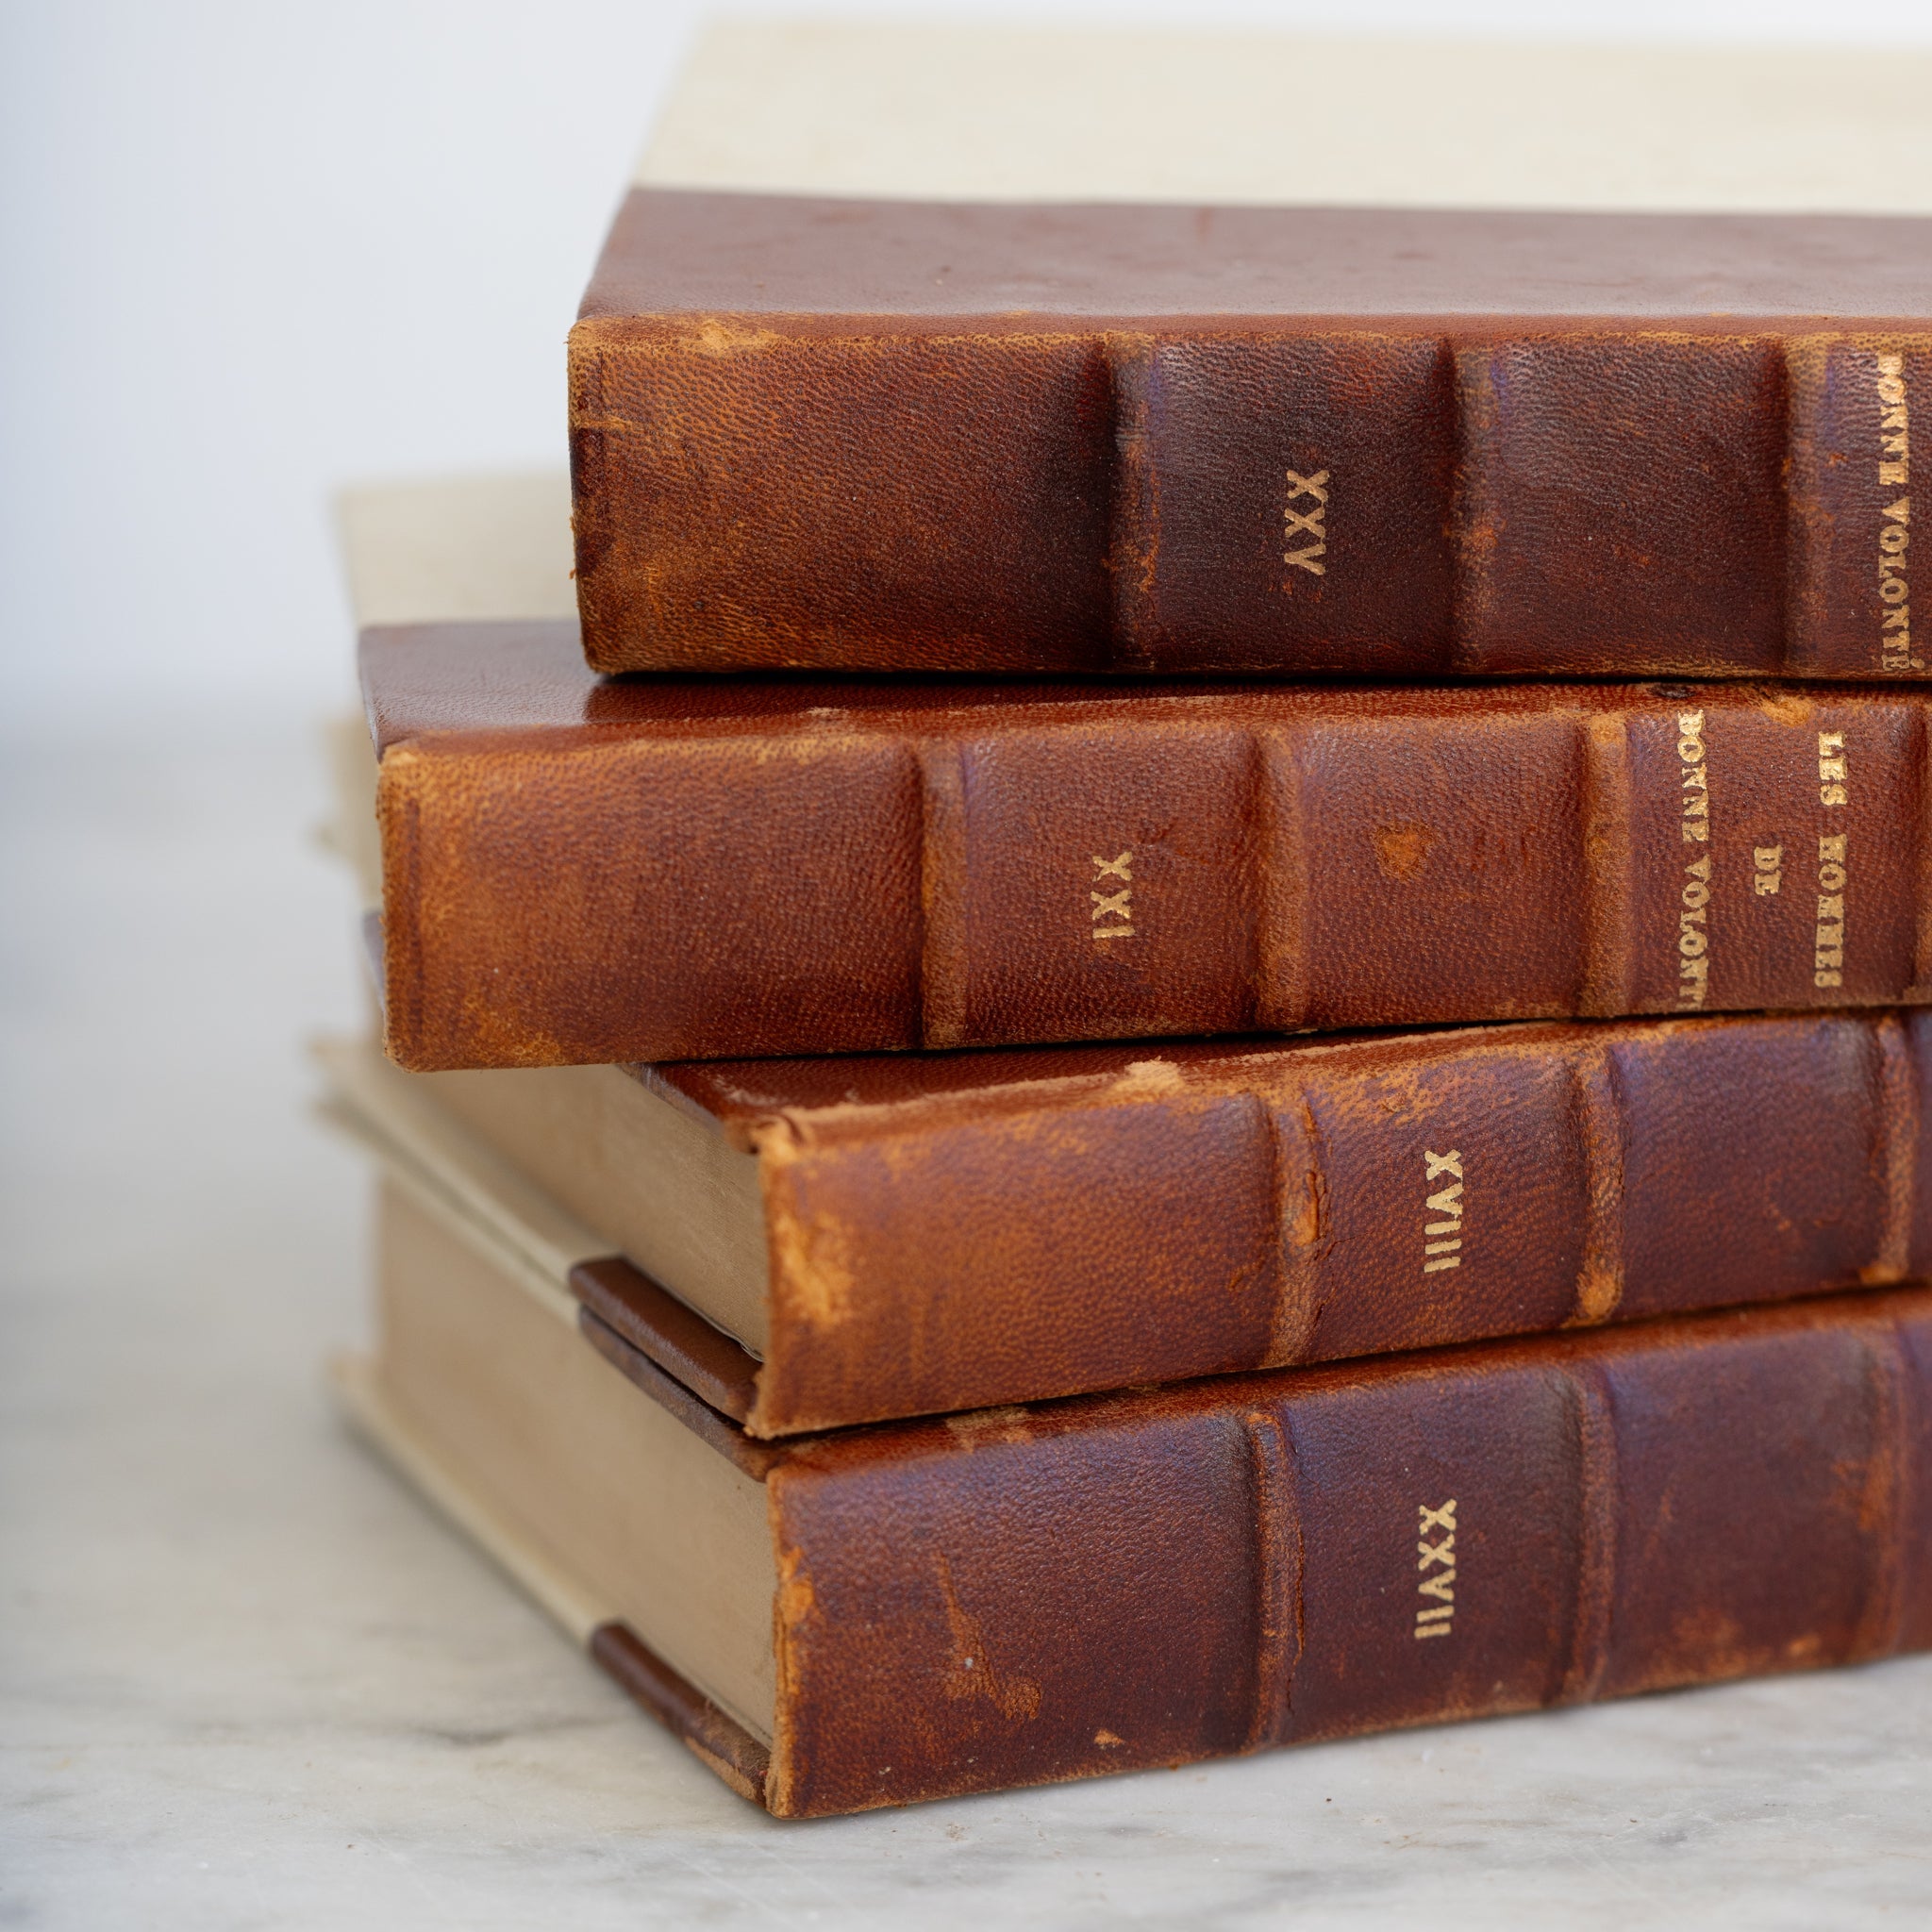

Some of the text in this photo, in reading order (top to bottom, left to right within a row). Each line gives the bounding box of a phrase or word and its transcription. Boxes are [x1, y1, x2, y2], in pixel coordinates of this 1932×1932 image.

[1284, 469, 1330, 576] XXV
[1876, 351, 1924, 672] BONNE VOLONTÉ
[1677, 708, 1709, 842] BONNE
[1091, 851, 1136, 940] XXI
[1754, 844, 1783, 896] DE
[1814, 731, 1848, 989] LES HOMMES
[1424, 1149, 1464, 1274] XVIII
[1414, 1498, 1457, 1641] XXVII
